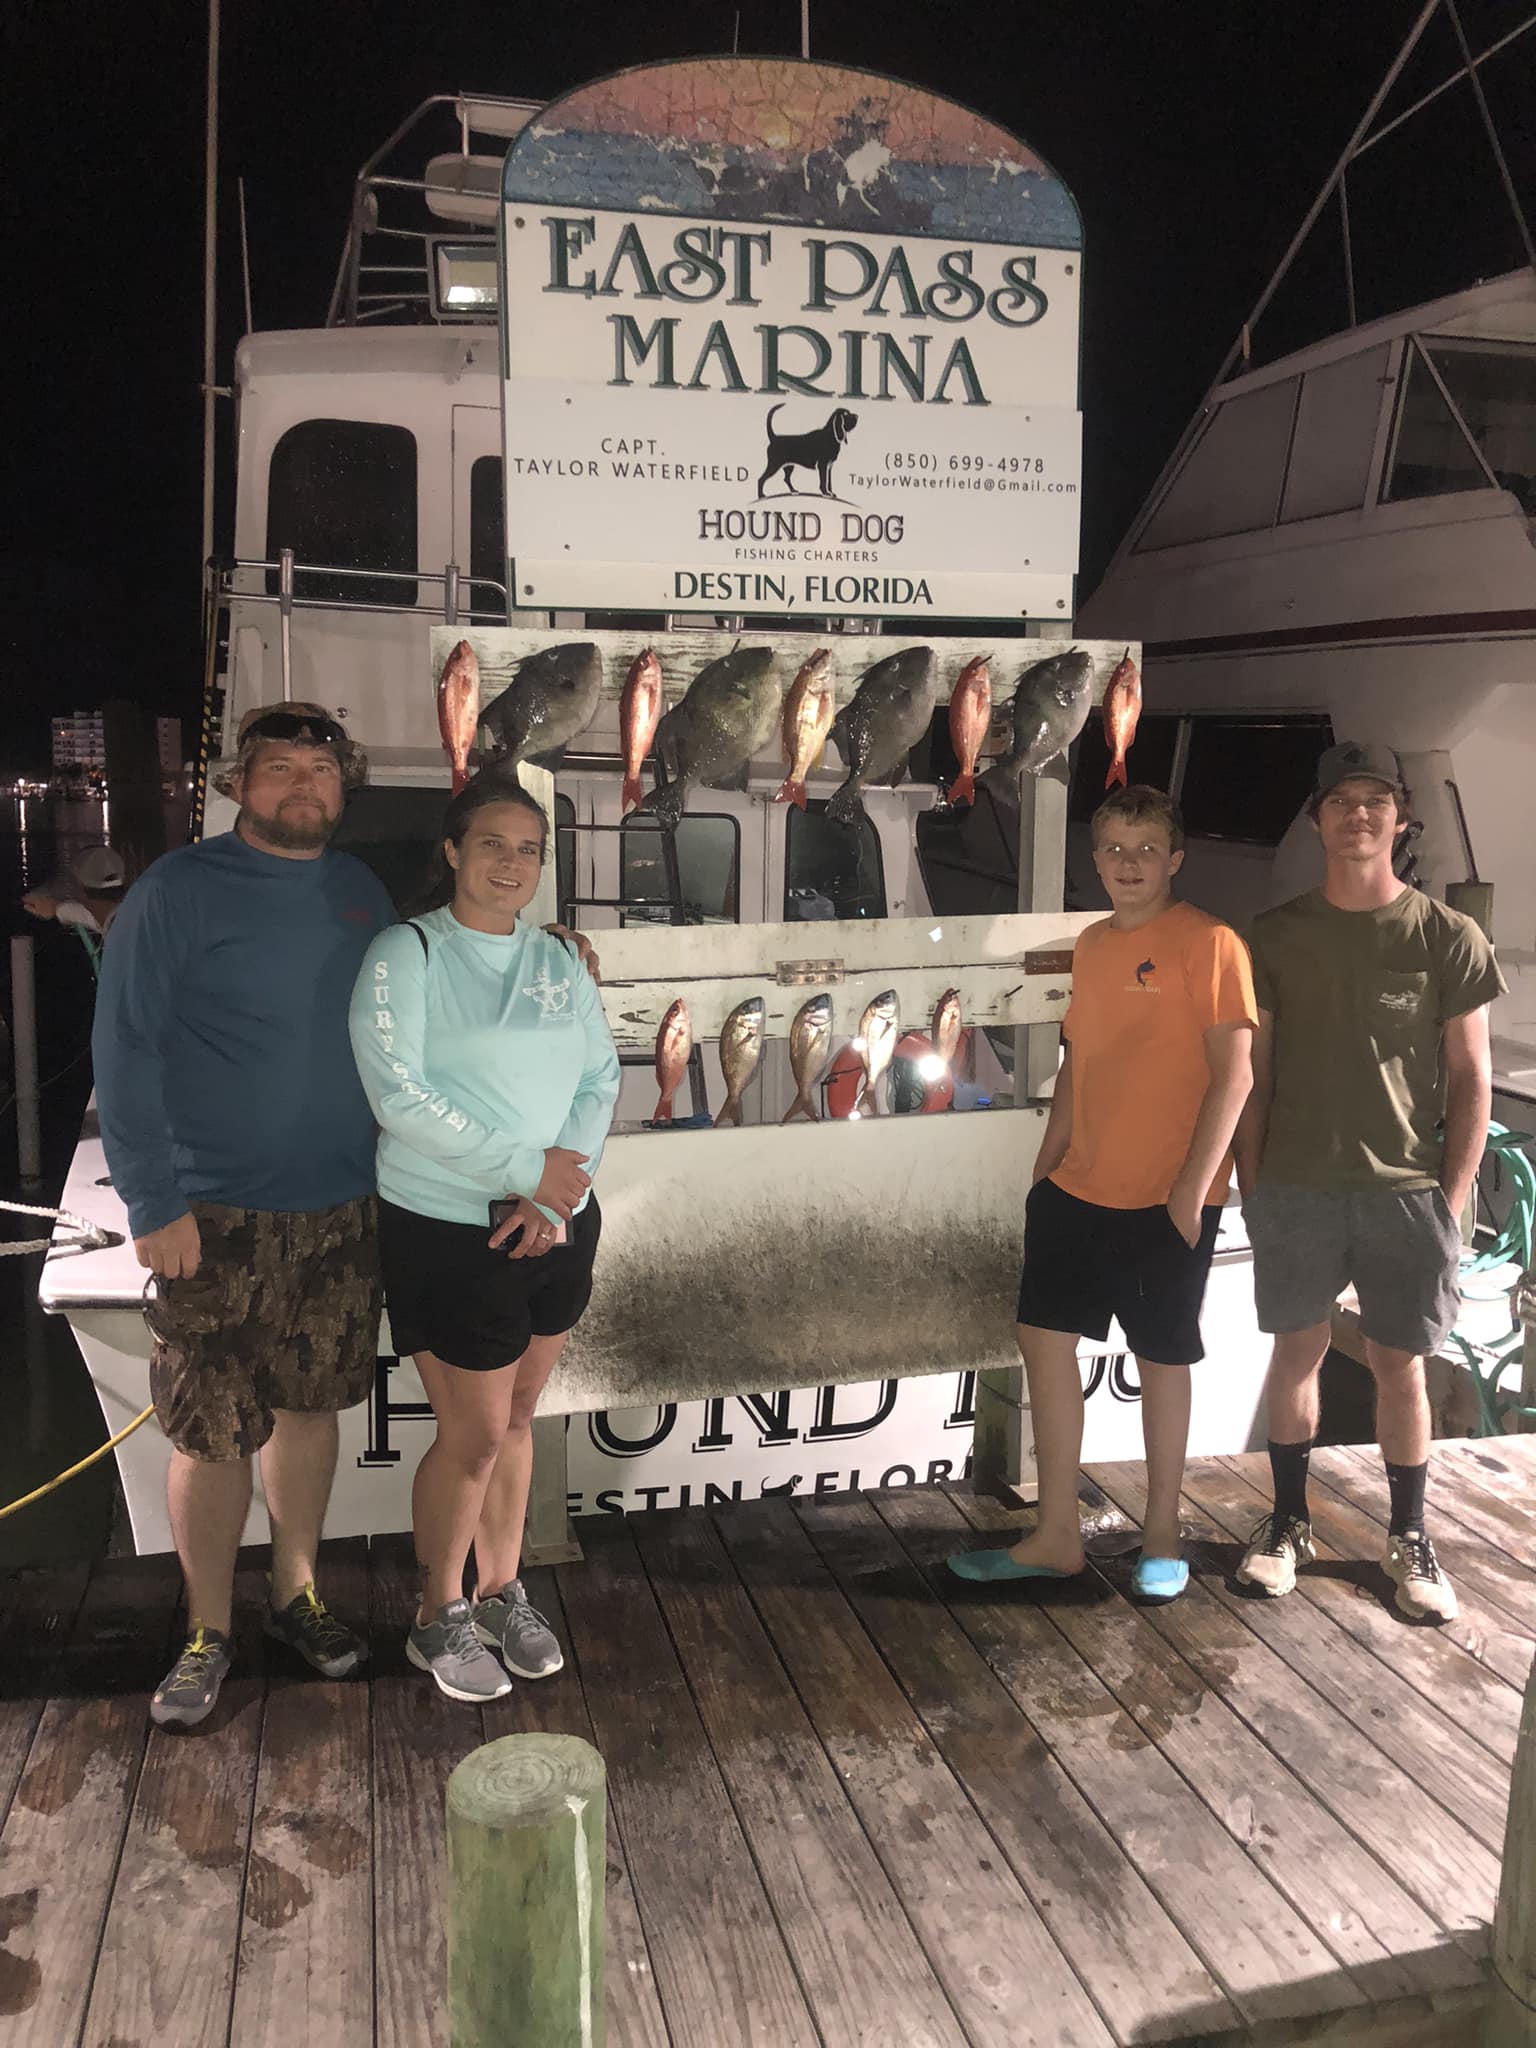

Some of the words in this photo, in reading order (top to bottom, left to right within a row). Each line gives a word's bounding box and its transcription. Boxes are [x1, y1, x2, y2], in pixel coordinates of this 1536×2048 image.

[541, 215, 772, 308] EAST
[800, 238, 1049, 329] PASS
[606, 313, 993, 407] MARINA
[601, 437, 666, 456] CAPT.
[514, 457, 600, 477] TAYLOR
[612, 461, 749, 482] WATERFIELD
[884, 453, 938, 472] (850)
[949, 455, 1045, 473] 699-4978
[848, 473, 1078, 493] TaylorWaterfield@Gmail.com
[698, 508, 822, 543] HOUND
[840, 512, 905, 545] DOG
[735, 548, 797, 561] FISHING
[804, 549, 879, 563] CHARTERS
[674, 571, 795, 608] DESTIN,
[805, 575, 934, 605] FLORIDA
[357, 1356, 899, 1470] HUND
